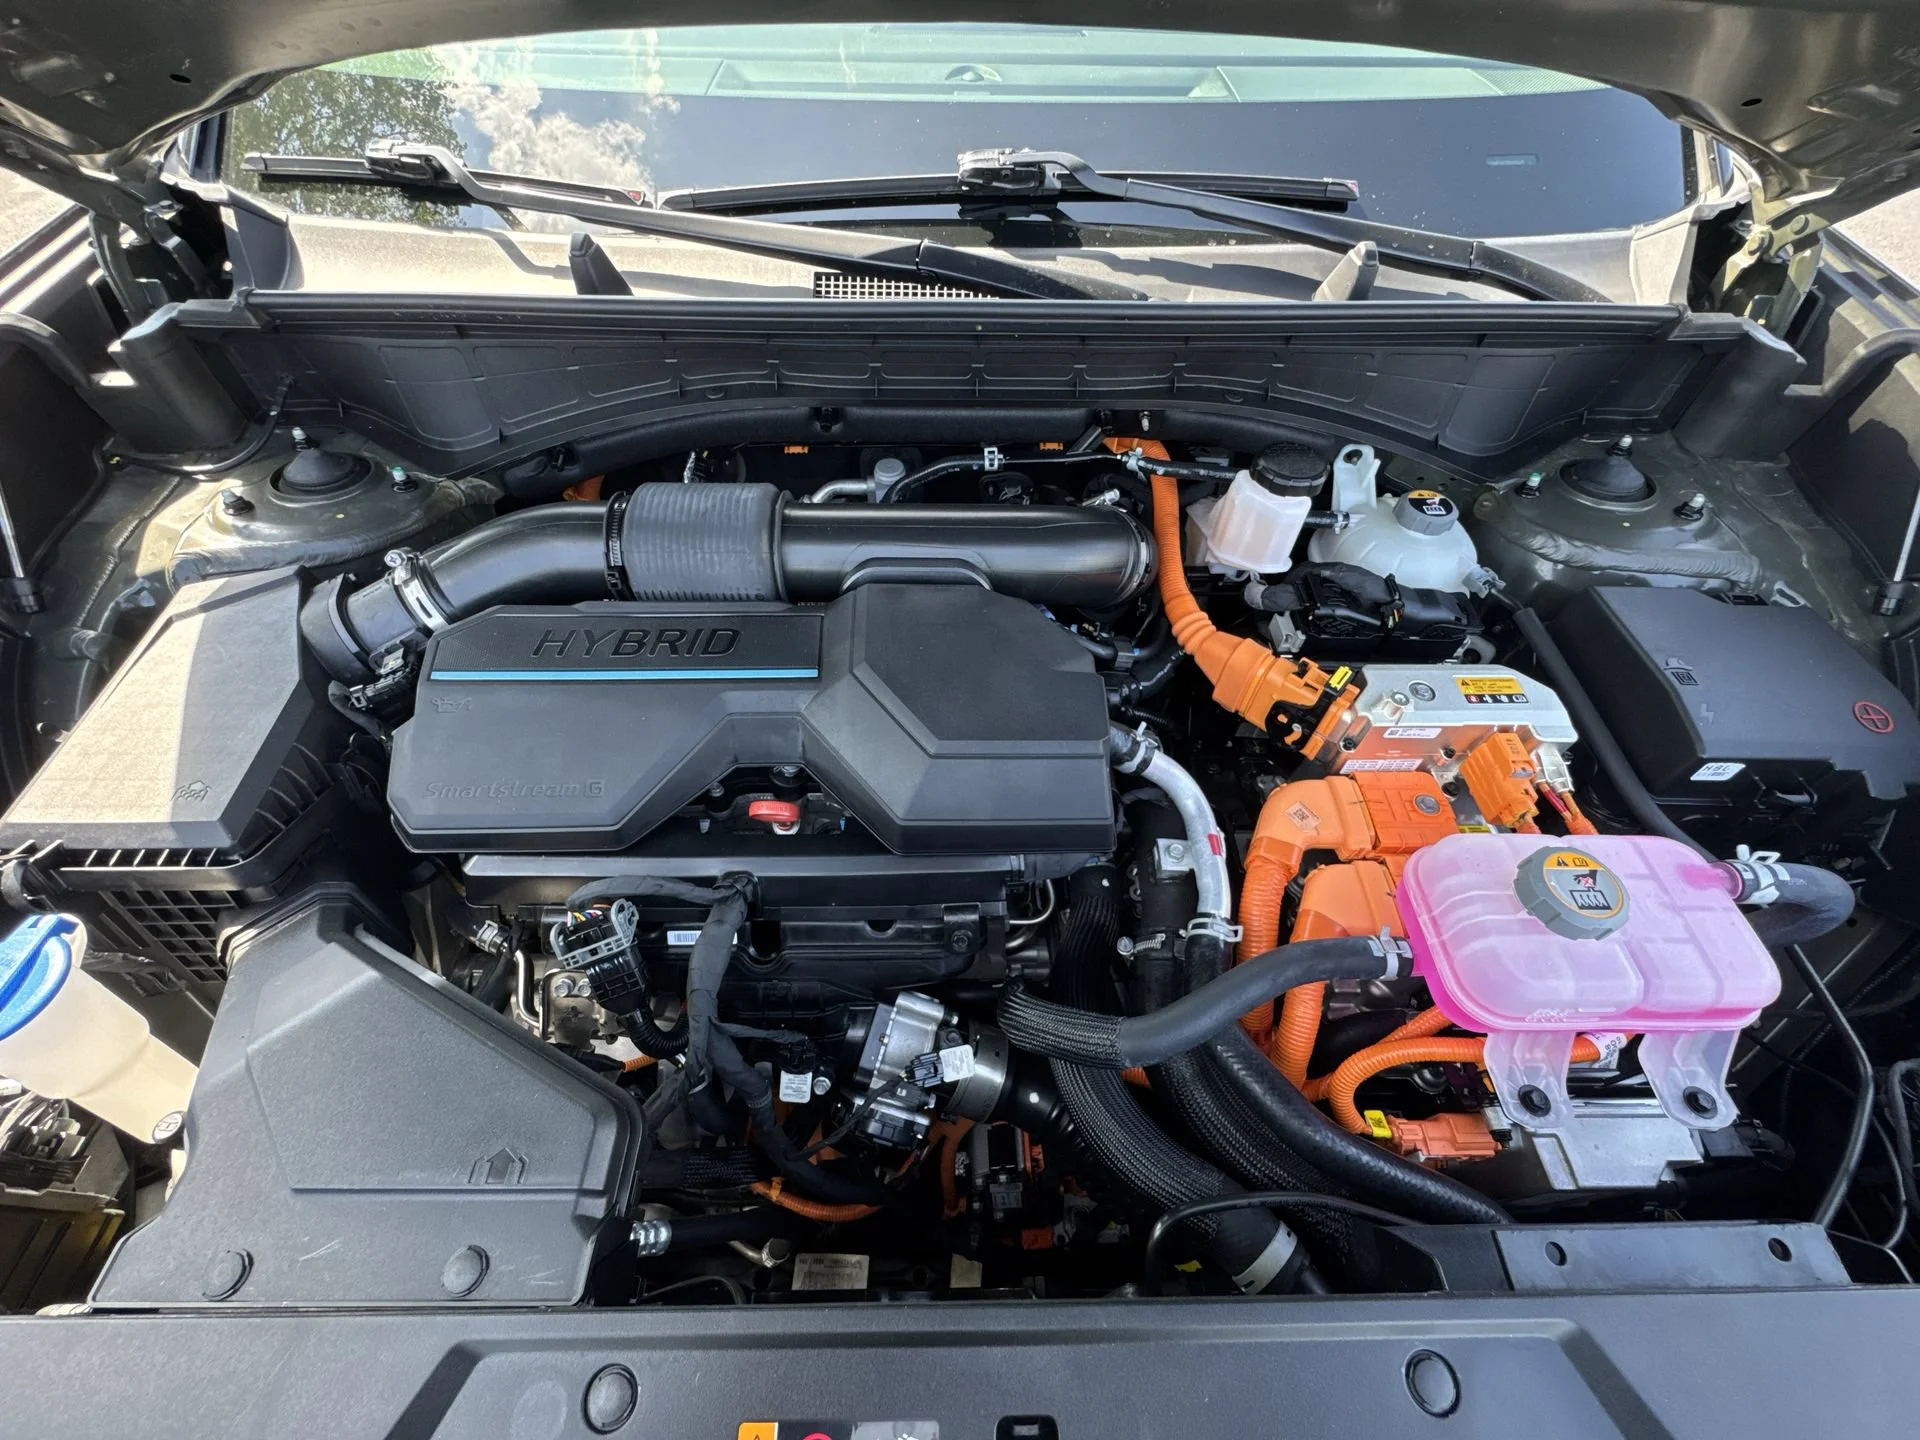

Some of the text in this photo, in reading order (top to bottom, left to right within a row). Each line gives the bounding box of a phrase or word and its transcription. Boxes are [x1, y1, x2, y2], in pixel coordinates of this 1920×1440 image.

[531, 627, 741, 658] HYBRID
[423, 780, 604, 799] Smartstream G
